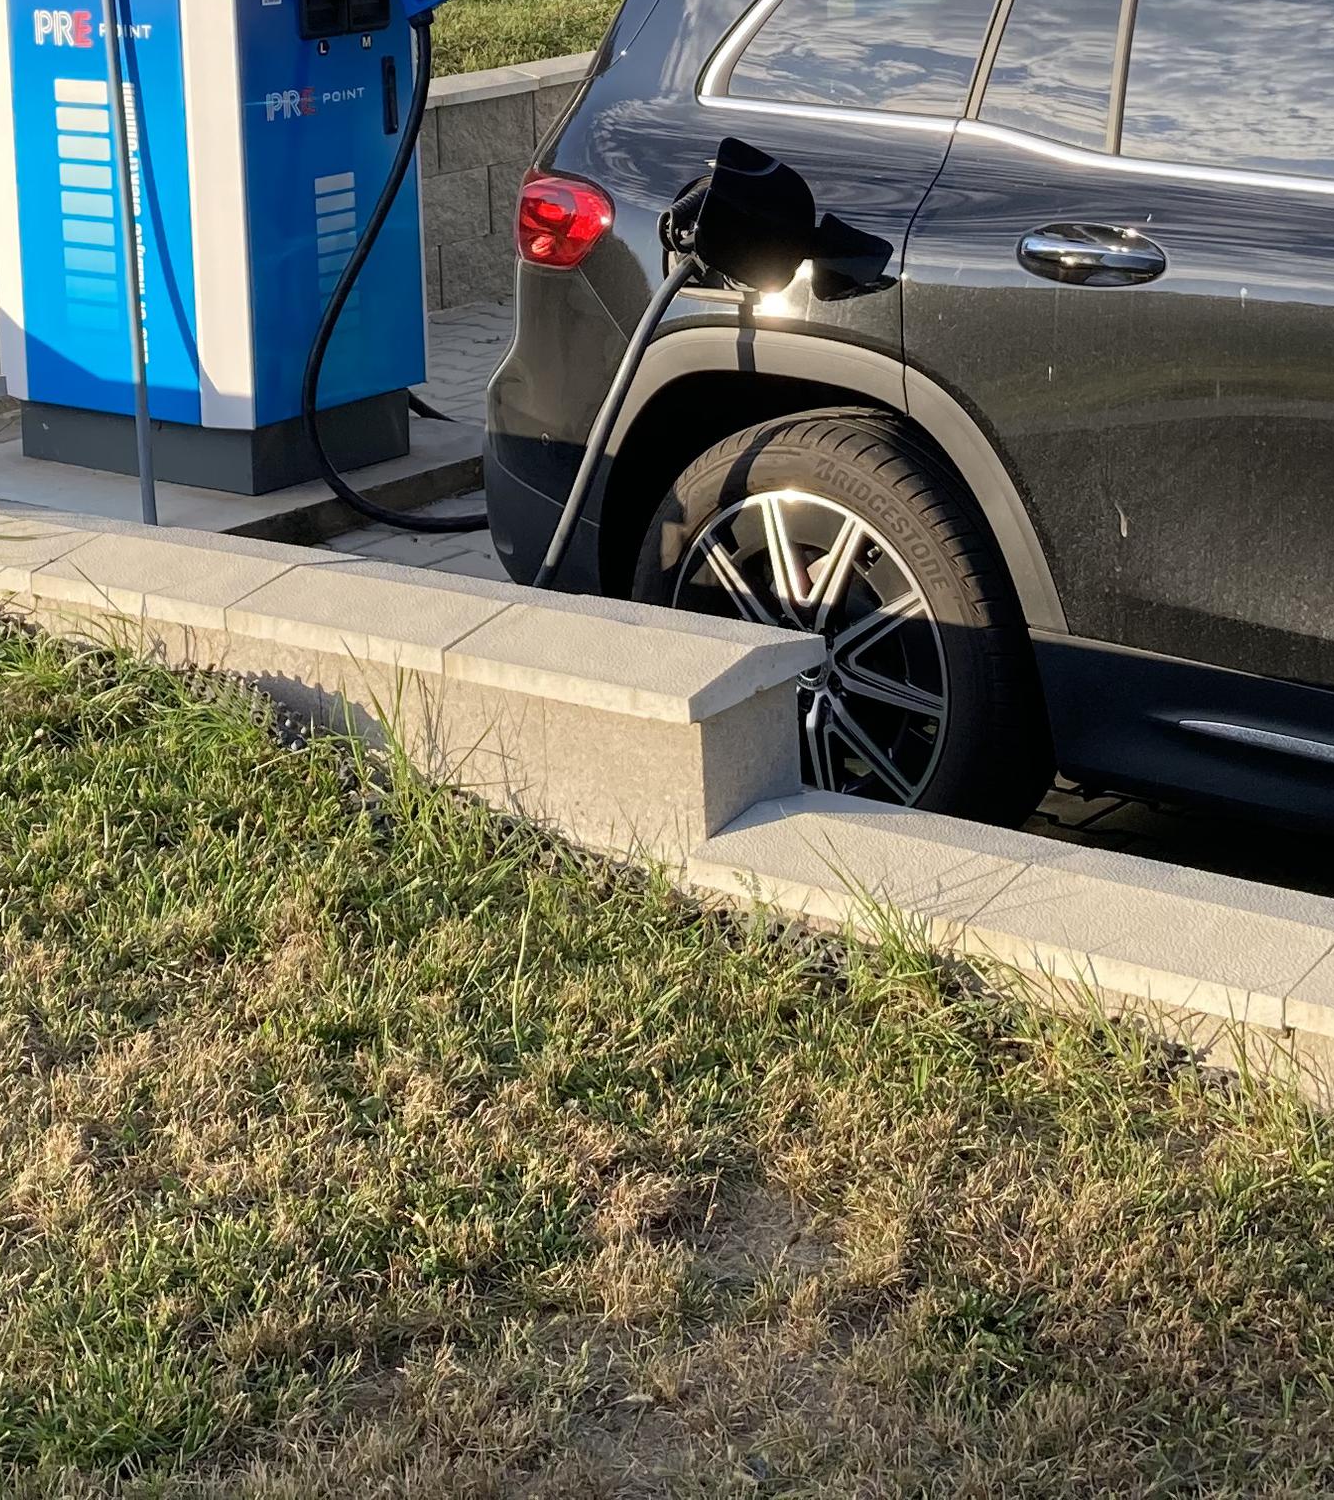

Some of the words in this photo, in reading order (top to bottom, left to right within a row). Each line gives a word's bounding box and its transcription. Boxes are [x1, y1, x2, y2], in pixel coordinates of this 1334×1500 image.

[32, 8, 93, 48] PRE
[362, 36, 372, 48] M
[319, 42, 327, 54] L
[265, 86, 316, 122] PRE
[322, 87, 365, 105] POINT
[814, 458, 951, 591] BRIDGESTONE
